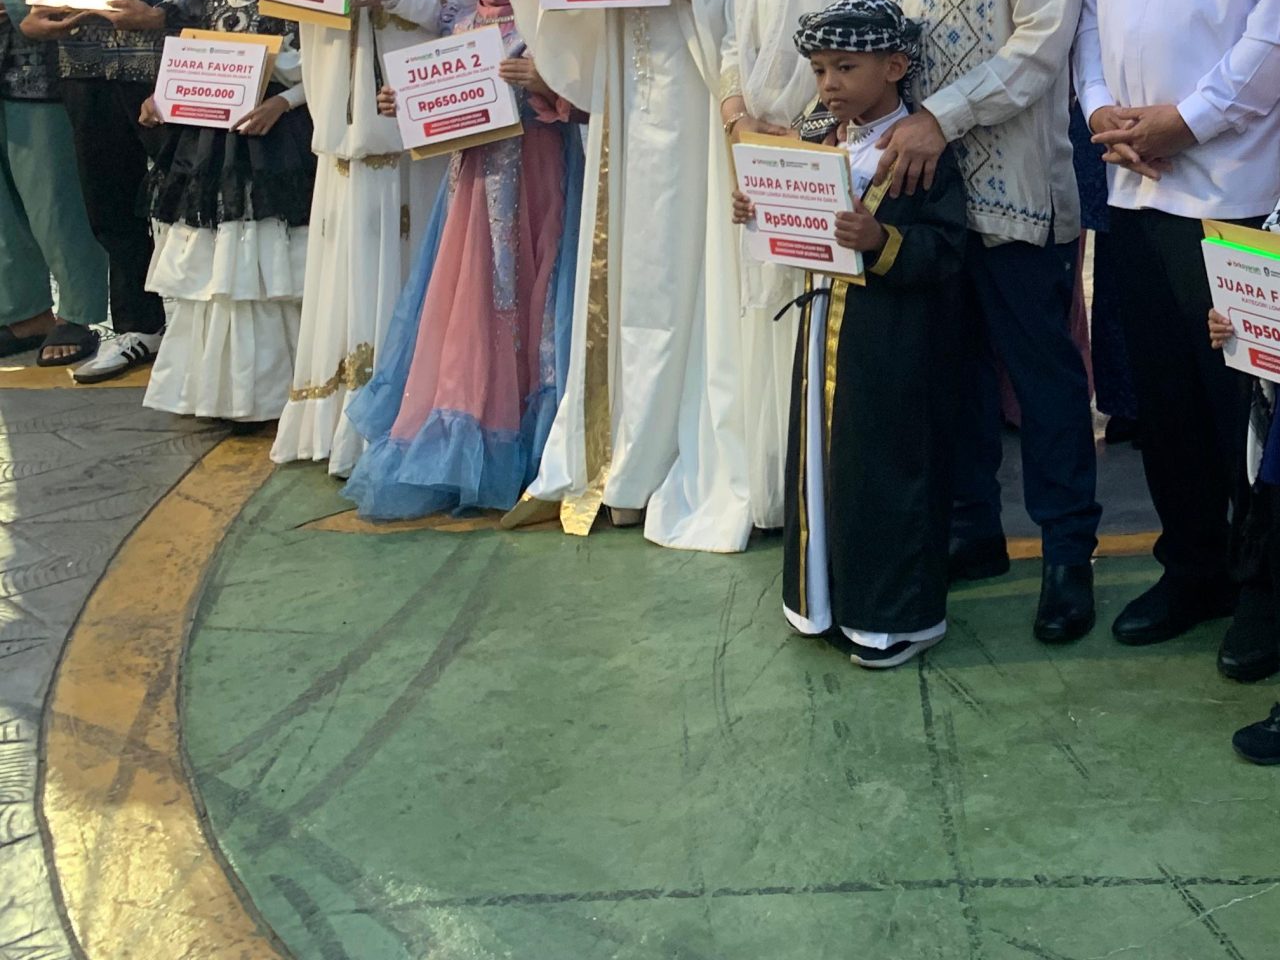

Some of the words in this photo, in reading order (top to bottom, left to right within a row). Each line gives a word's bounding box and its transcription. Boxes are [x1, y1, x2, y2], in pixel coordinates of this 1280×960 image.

[167, 58, 204, 70] JUARA
[208, 62, 255, 74] FAVORIT
[407, 57, 468, 84] JUARA
[471, 54, 482, 68] 2
[175, 85, 235, 99] Rp500.000
[417, 87, 485, 113] Rp650.000
[744, 175, 783, 190] JUARA
[785, 179, 836, 196] FAVORIT
[764, 212, 829, 231] Rp500.000
[1216, 276, 1266, 301] JUARA
